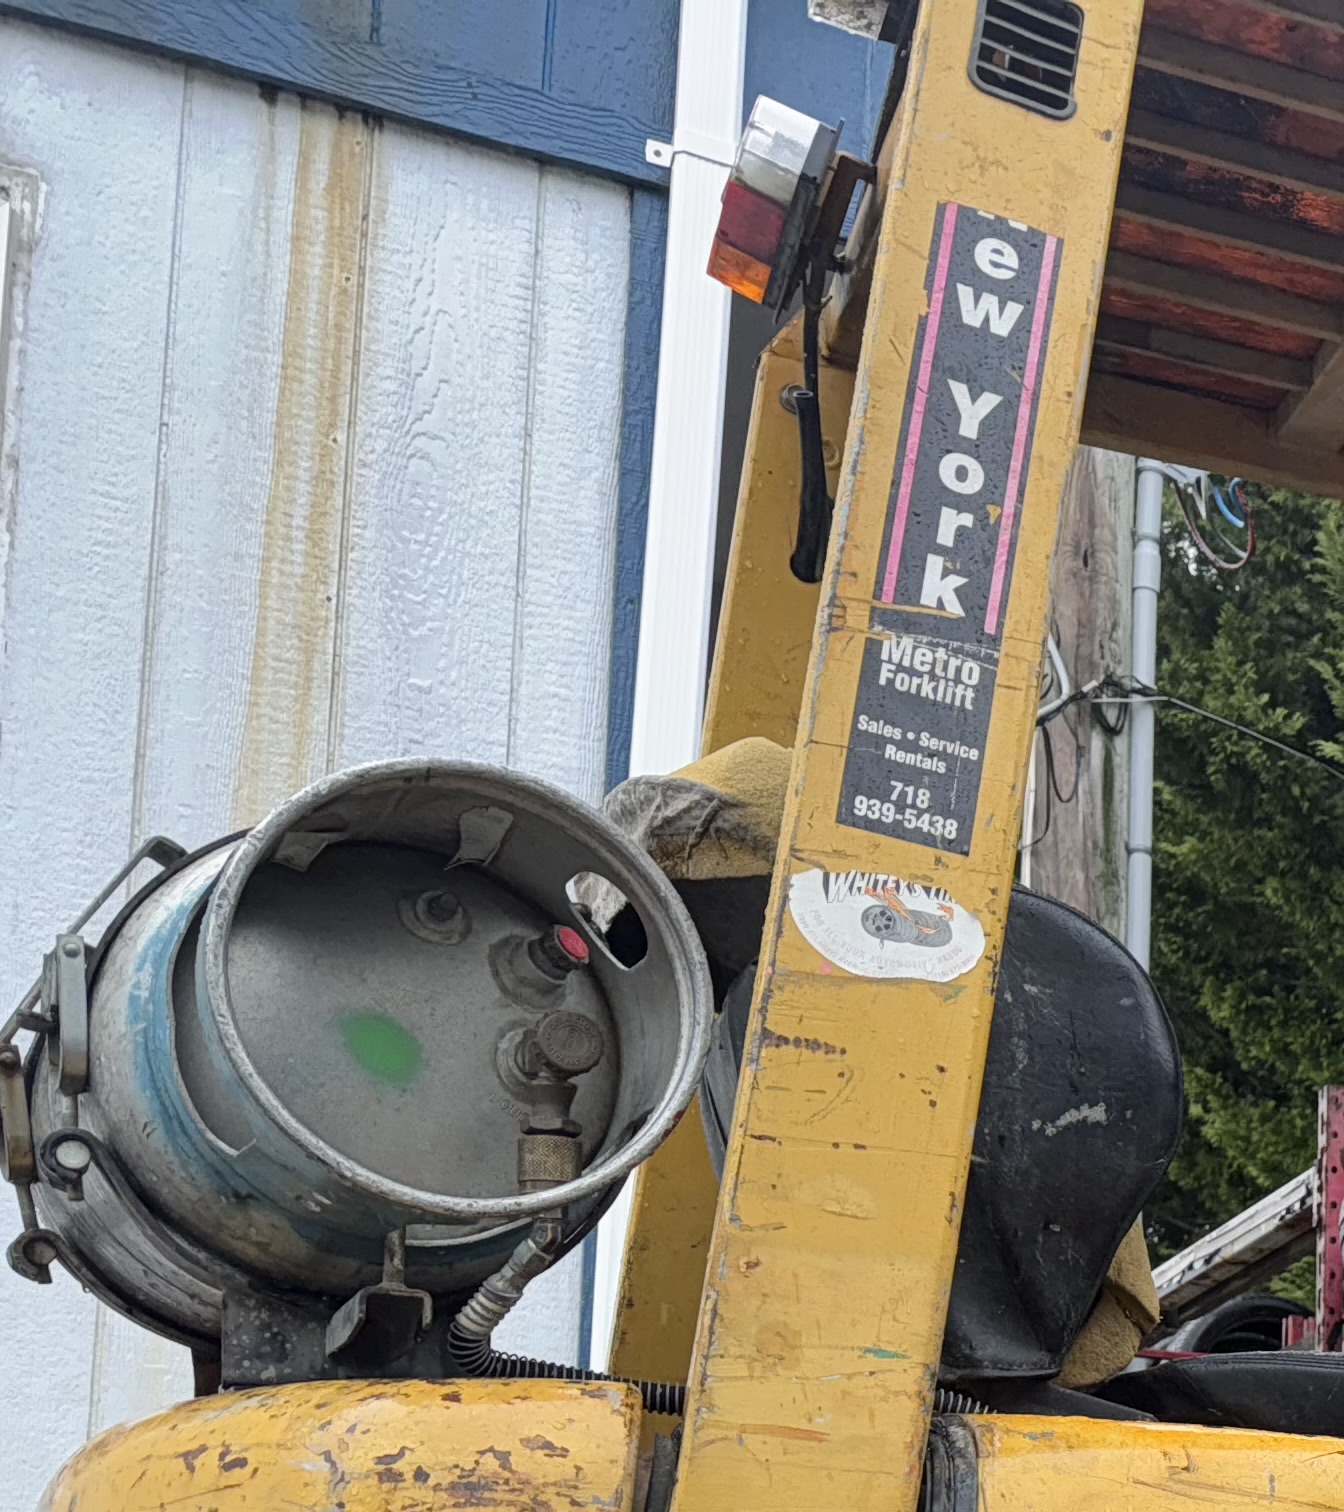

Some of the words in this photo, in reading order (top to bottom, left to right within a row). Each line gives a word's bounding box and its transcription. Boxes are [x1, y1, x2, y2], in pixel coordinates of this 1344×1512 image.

[956, 210, 1028, 338] ew
[919, 378, 1004, 617] York
[880, 635, 981, 686] Metro
[878, 662, 976, 710] Forklift
[857, 714, 902, 741] Sales
[918, 731, 979, 761] Service
[884, 743, 947, 774] Rentals
[853, 795, 959, 840] 939-5438
[890, 780, 931, 809] 718
